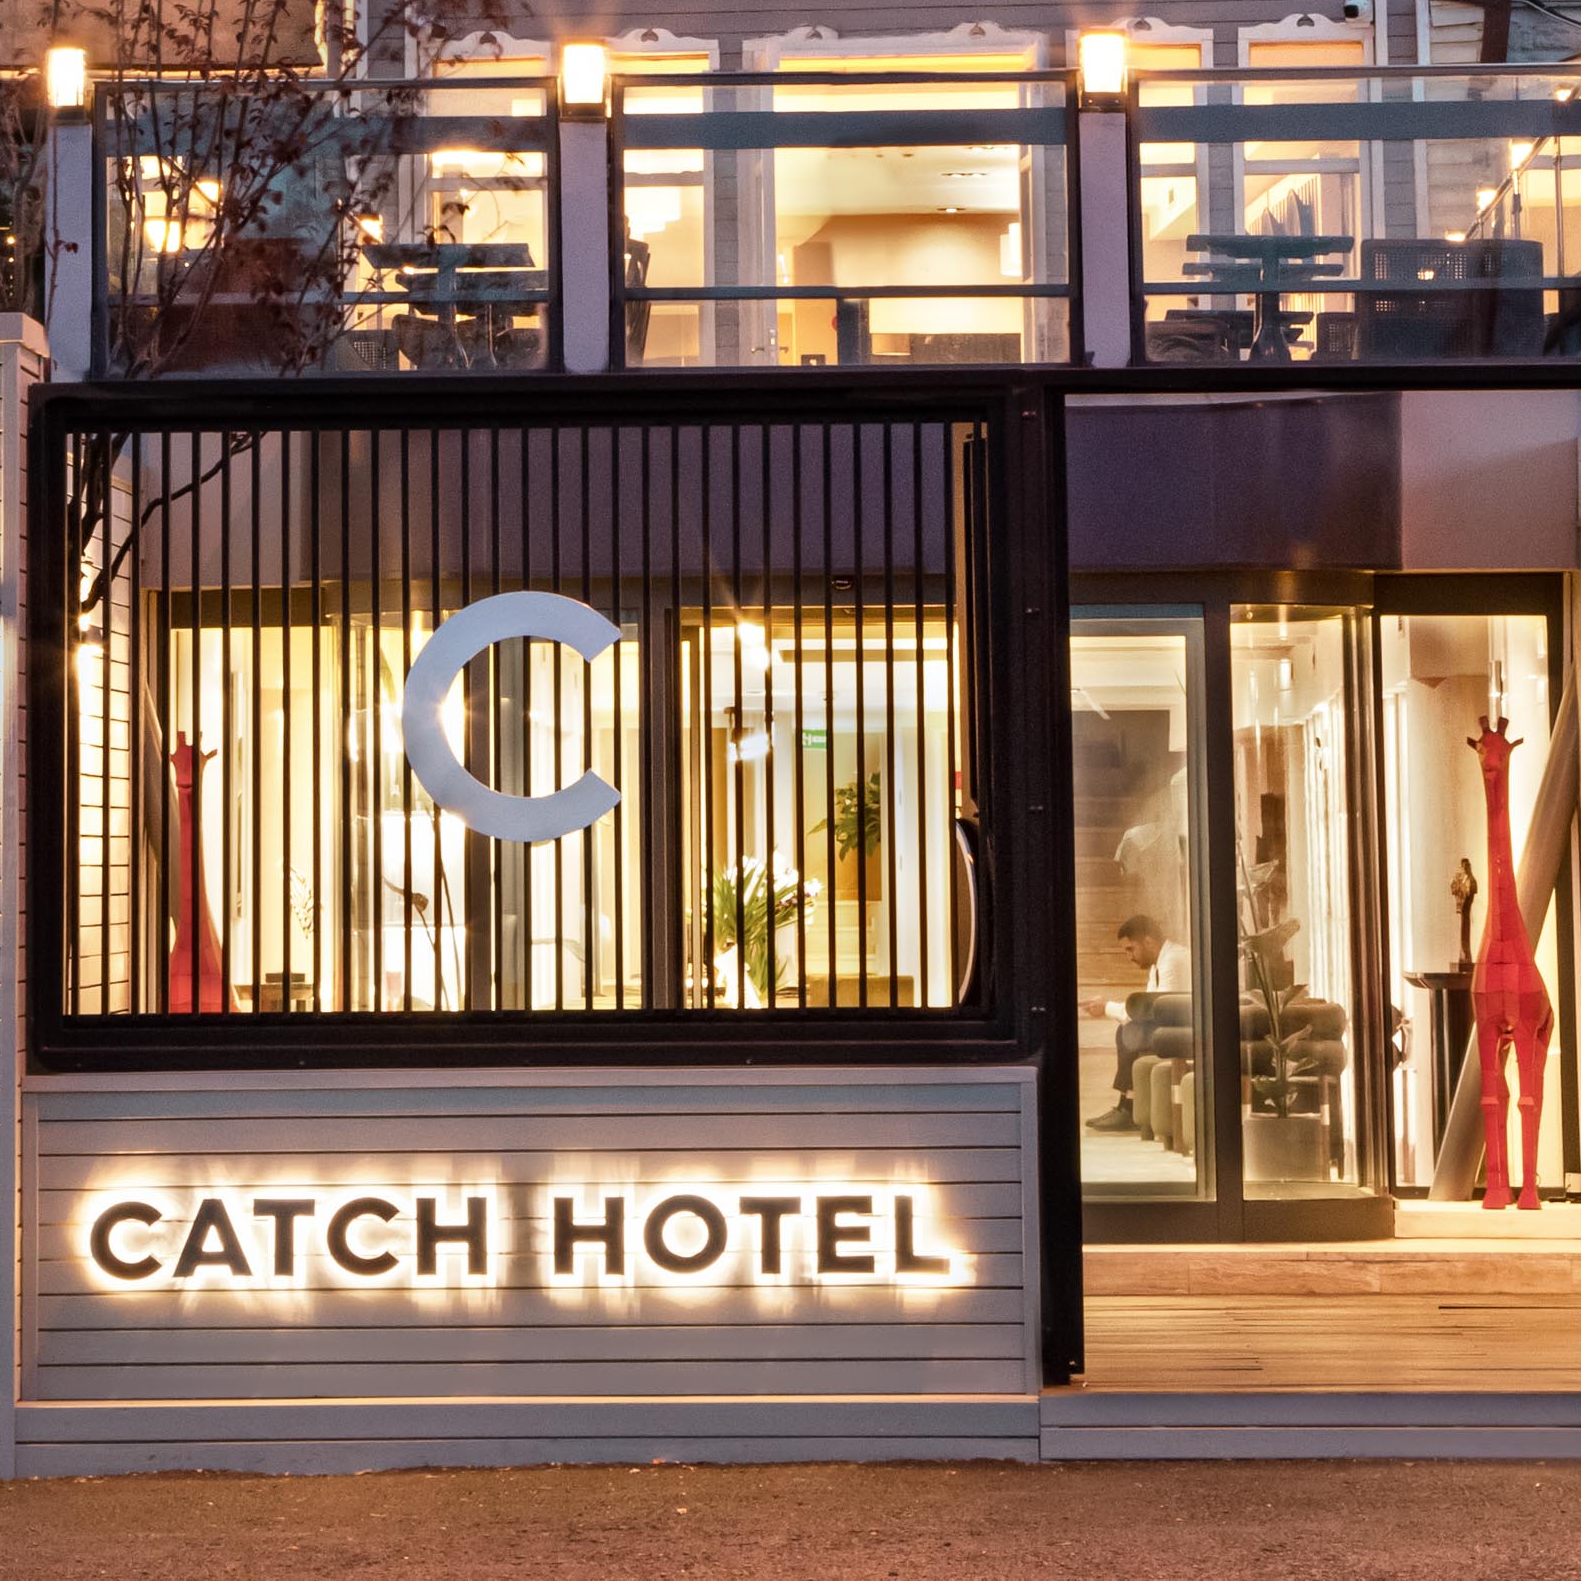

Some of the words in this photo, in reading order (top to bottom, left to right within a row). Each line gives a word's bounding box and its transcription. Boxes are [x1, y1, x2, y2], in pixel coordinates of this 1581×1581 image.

[402, 591, 622, 842] C
[90, 1196, 488, 1280] CATCH
[553, 1194, 951, 1275] HOTEL
